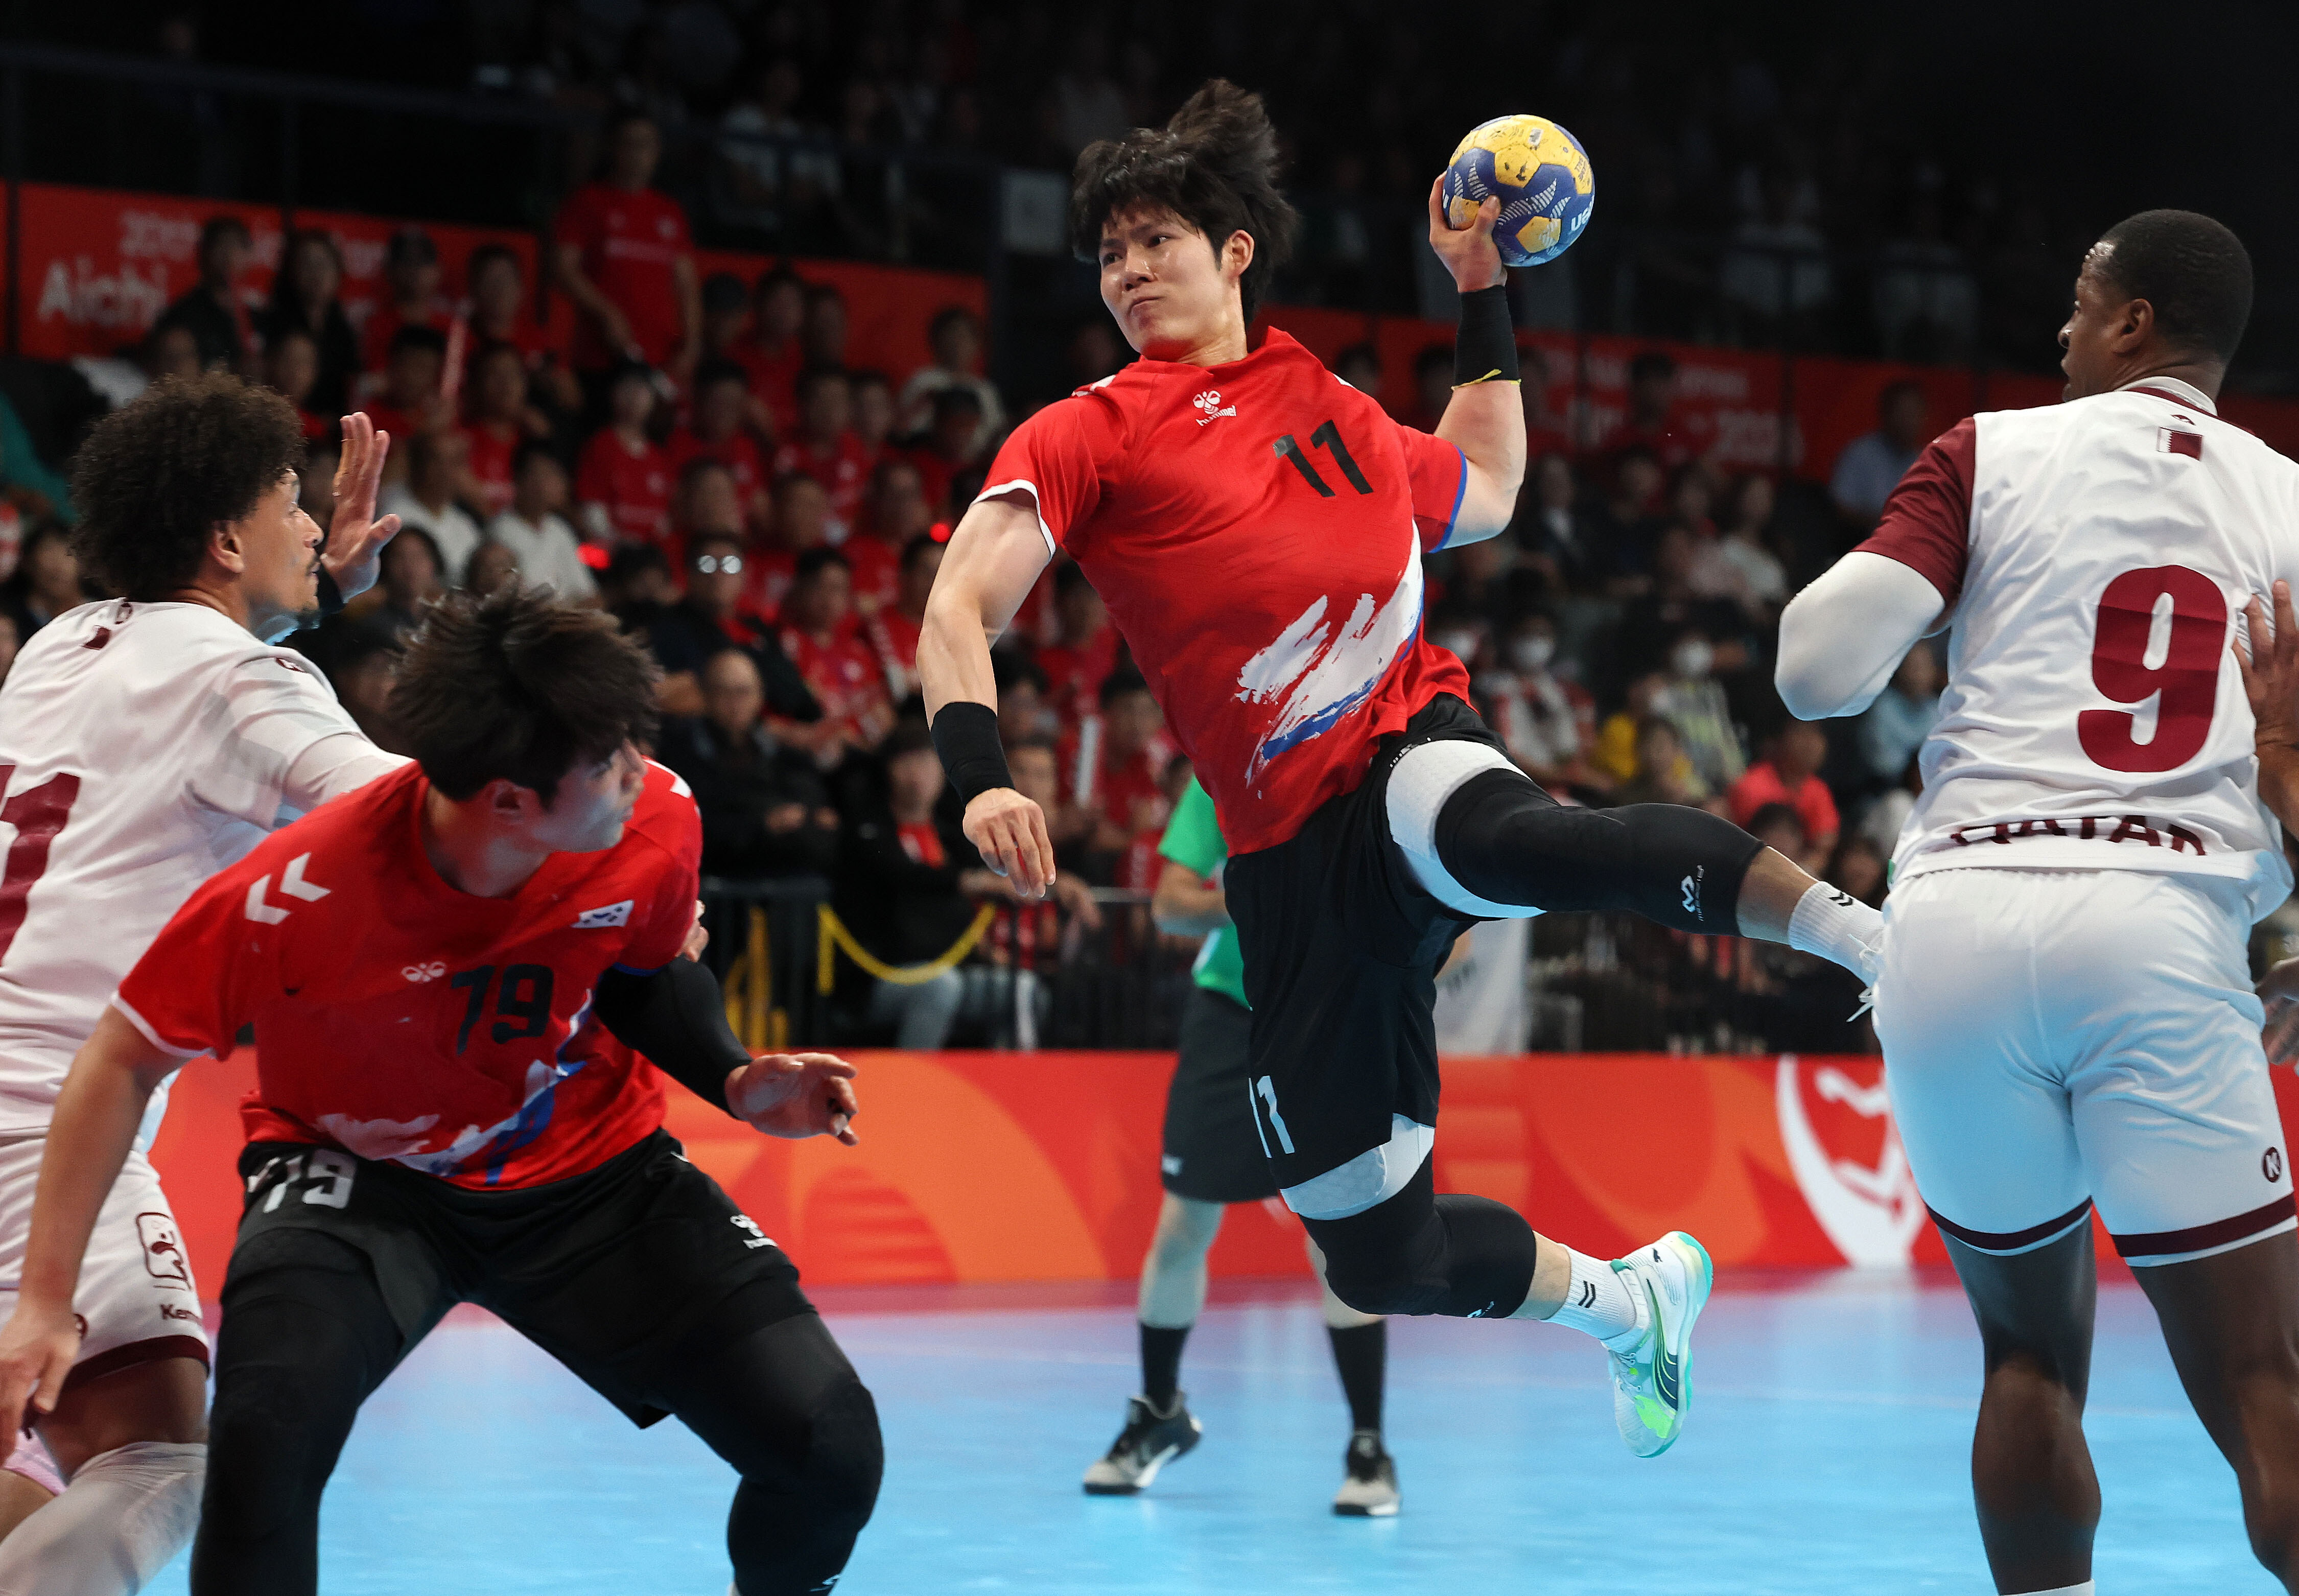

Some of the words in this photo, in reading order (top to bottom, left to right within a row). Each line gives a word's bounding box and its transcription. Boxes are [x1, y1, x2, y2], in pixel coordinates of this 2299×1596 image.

[1272, 419, 1374, 498] 11
[2078, 565, 2227, 772] 9
[0, 765, 81, 967] 1
